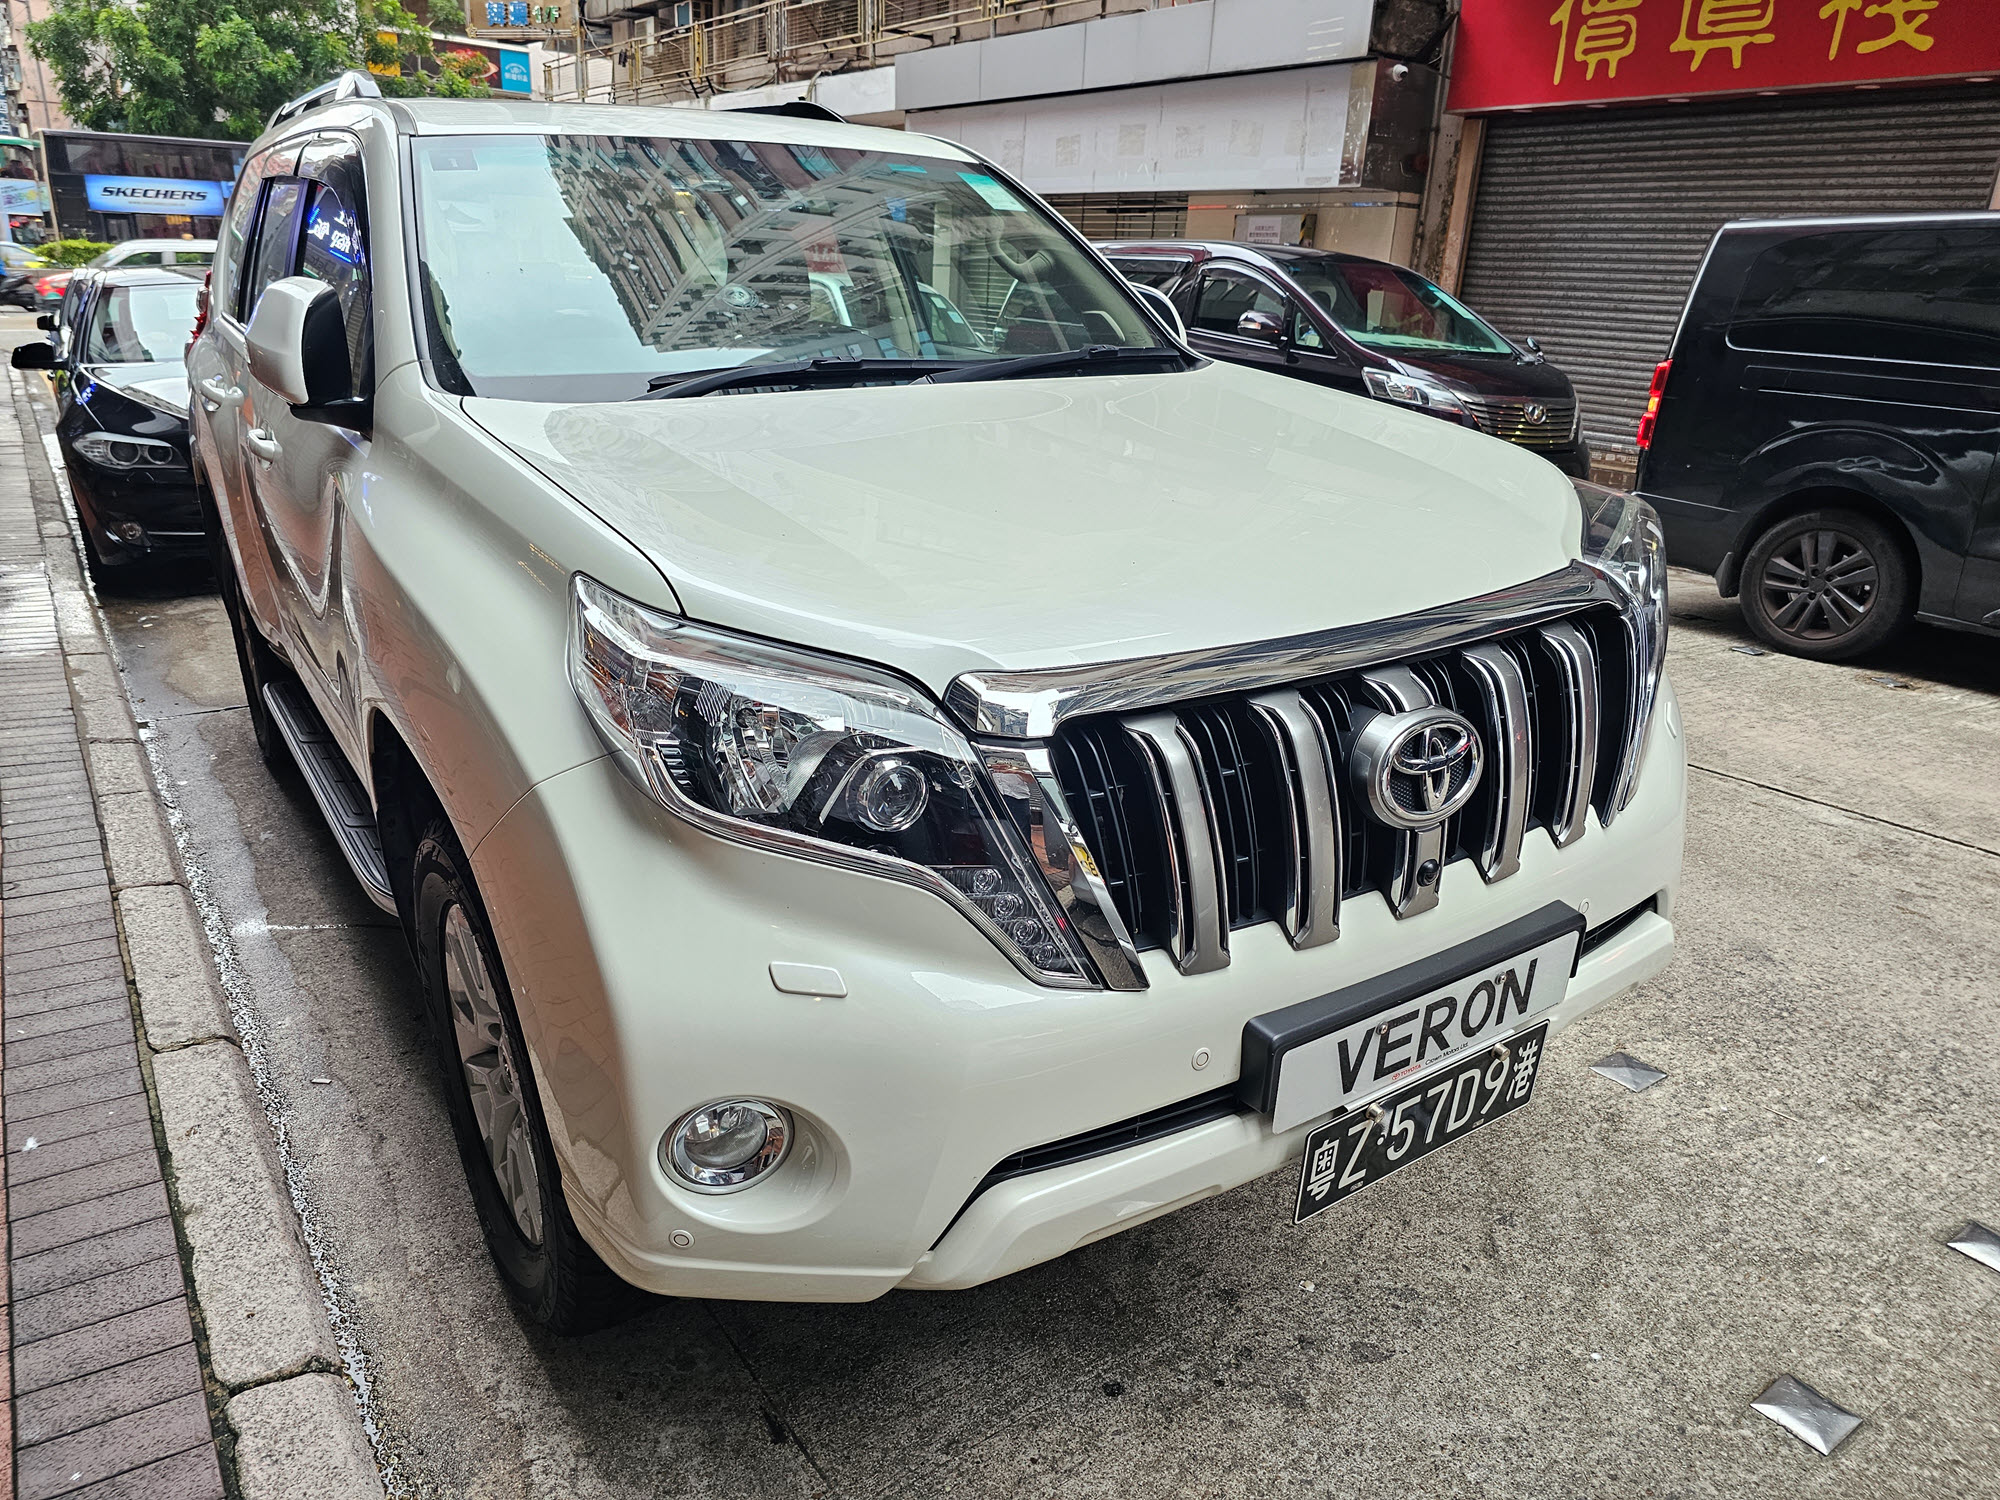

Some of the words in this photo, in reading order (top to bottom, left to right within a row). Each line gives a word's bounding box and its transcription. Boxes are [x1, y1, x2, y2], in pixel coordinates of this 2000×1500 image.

[101, 186, 208, 201] SKECHERS
[1337, 958, 1538, 1095] VERON
[1400, 1064, 1422, 1076] TOYOTA
